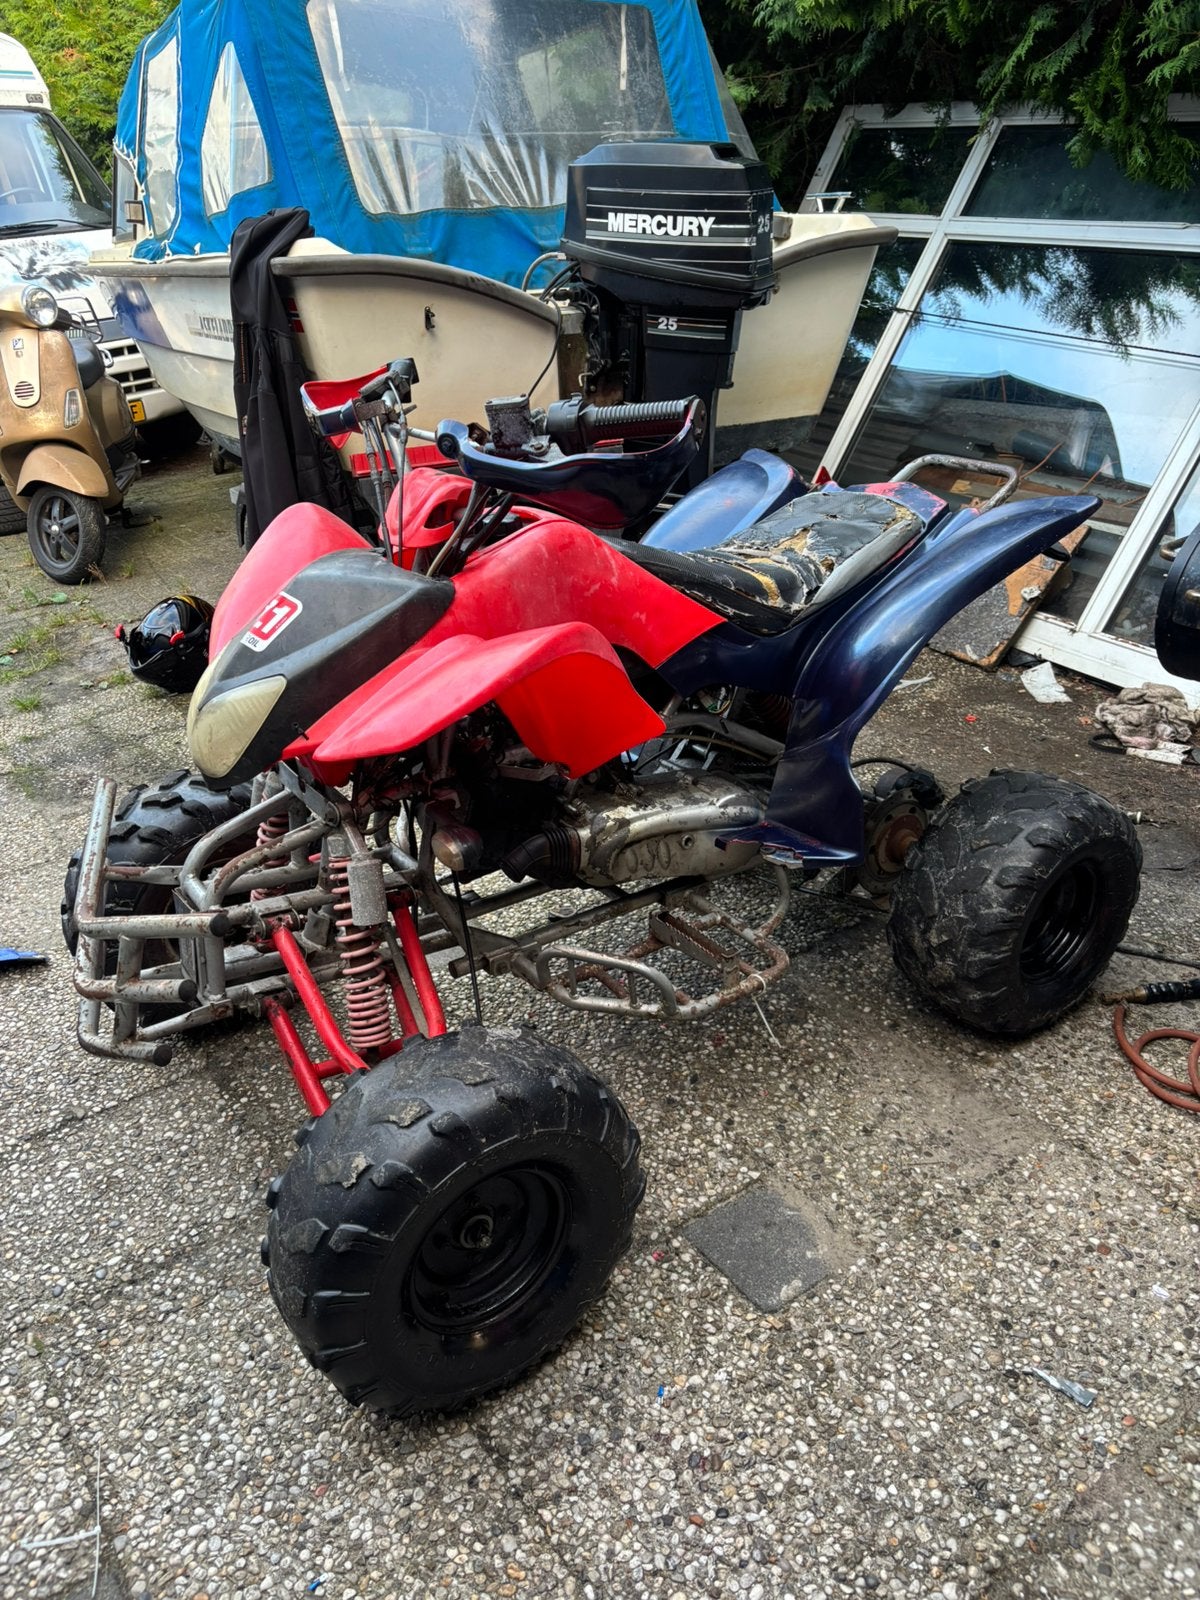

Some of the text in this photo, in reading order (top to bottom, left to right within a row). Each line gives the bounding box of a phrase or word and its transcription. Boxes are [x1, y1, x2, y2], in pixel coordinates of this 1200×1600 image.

[607, 211, 716, 237] MERCURY
[757, 213, 770, 234] 25
[657, 317, 678, 331] 25
